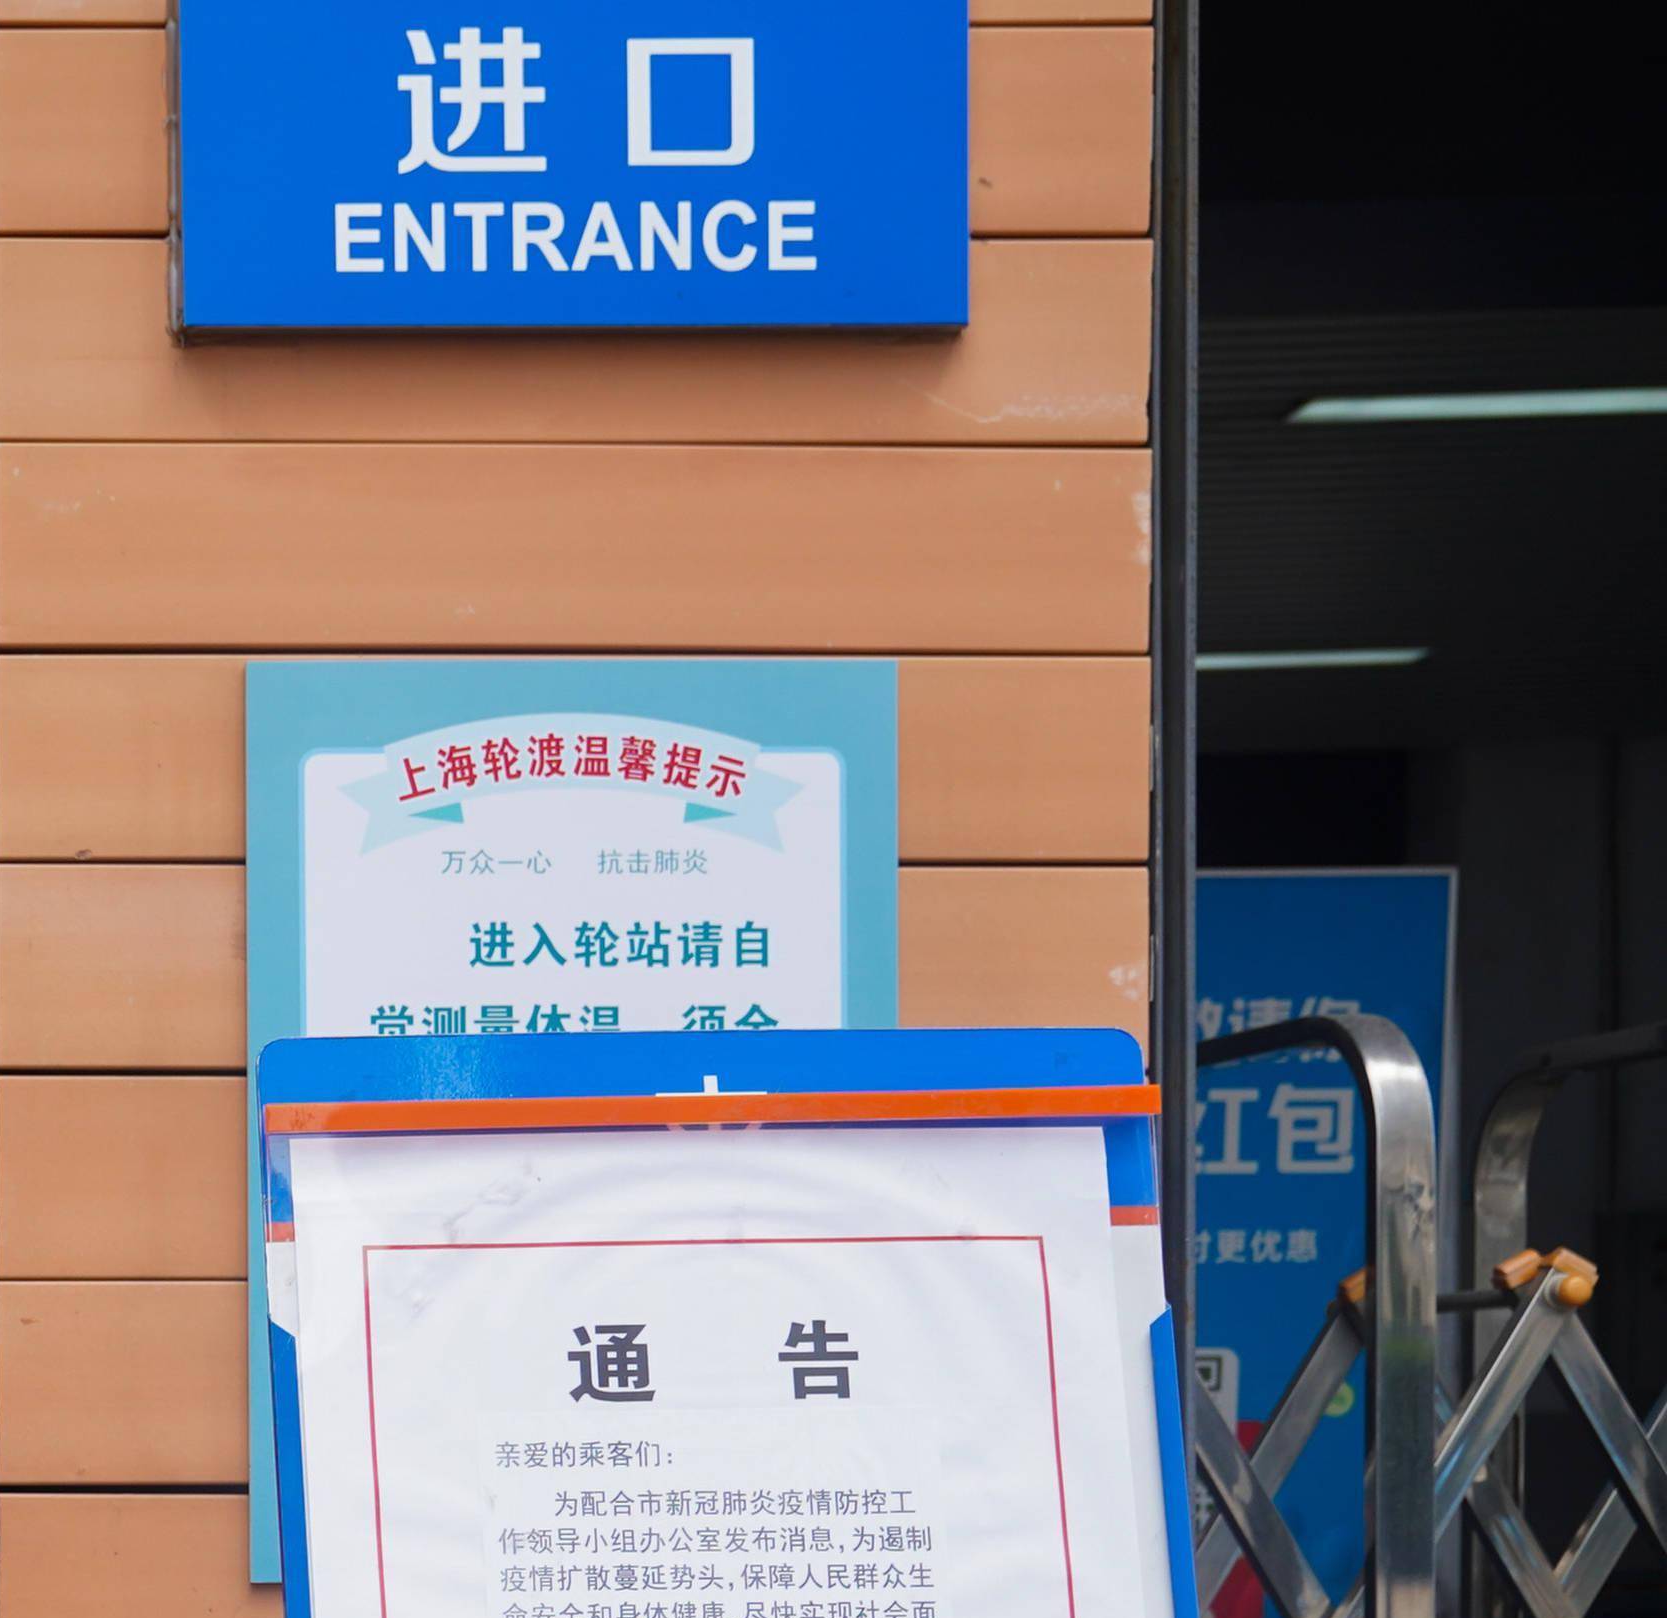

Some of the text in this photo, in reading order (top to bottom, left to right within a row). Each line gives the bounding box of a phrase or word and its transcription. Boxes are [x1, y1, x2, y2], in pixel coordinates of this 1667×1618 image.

[397, 26, 755, 175] 进口
[334, 199, 817, 274] ENTRANCE
[397, 732, 748, 802] 上海轮渡温馨提示
[441, 849, 709, 874] 万众一心 抗击肺炎
[469, 920, 770, 969] 进入轮站请自
[566, 1319, 860, 1403] 通告
[554, 1488, 917, 1518] 为配合市新冠肺炎疫情防控工
